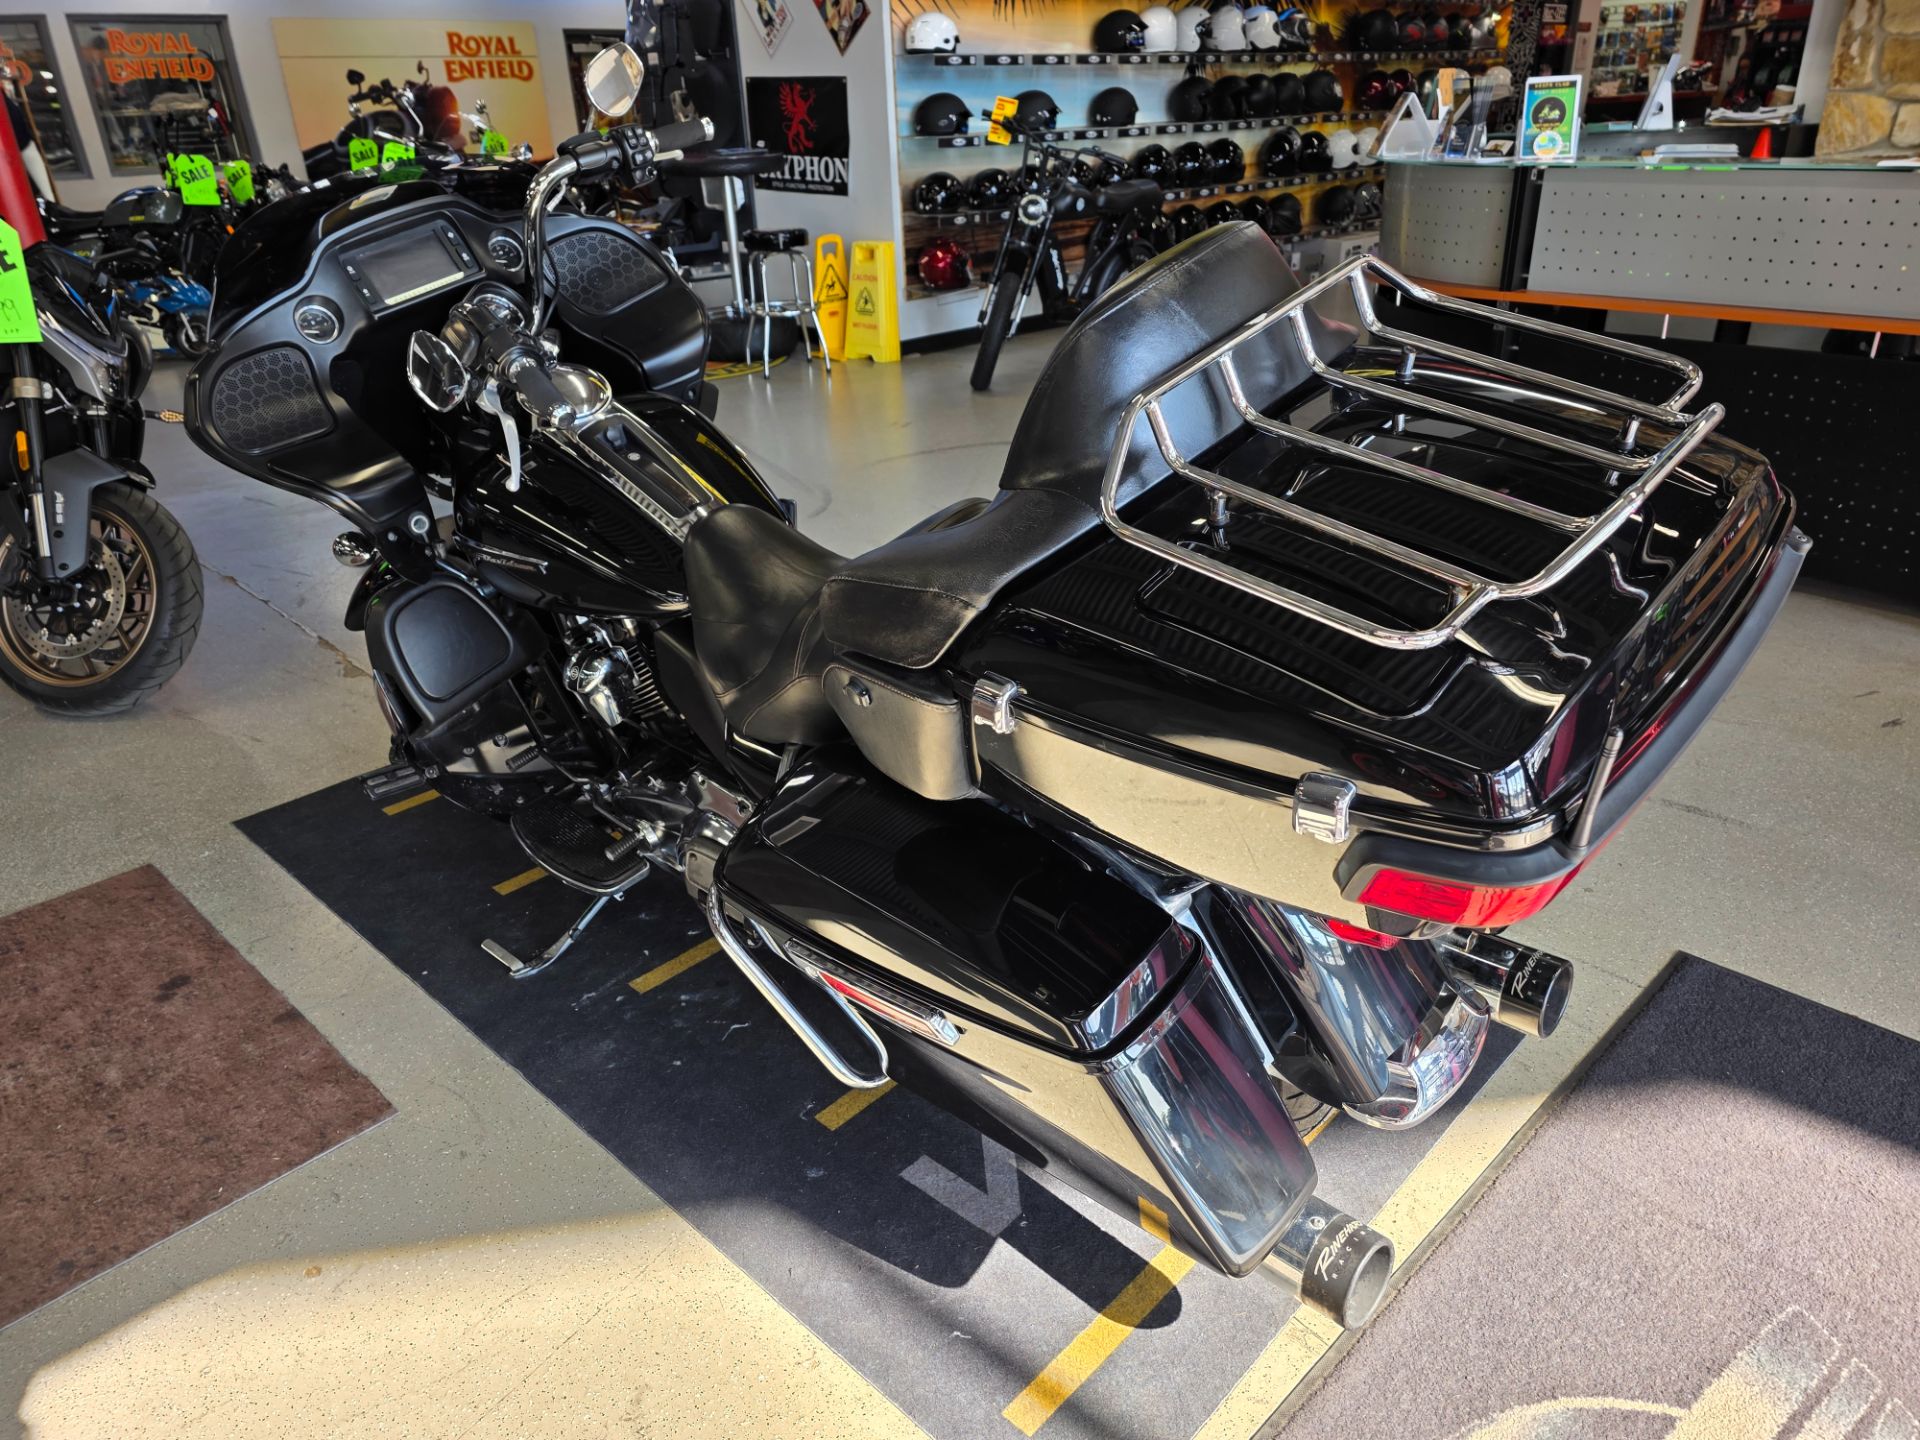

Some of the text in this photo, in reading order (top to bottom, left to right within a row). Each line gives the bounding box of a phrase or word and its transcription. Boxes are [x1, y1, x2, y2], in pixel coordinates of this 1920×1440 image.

[106, 28, 197, 56] ROYAL
[446, 31, 522, 57] ROYAL
[104, 57, 215, 84] ENFIELD
[443, 60, 534, 82] ENFIELD
[352, 147, 375, 163] SALE
[181, 164, 210, 184] SALE
[759, 154, 849, 183] YPHON
